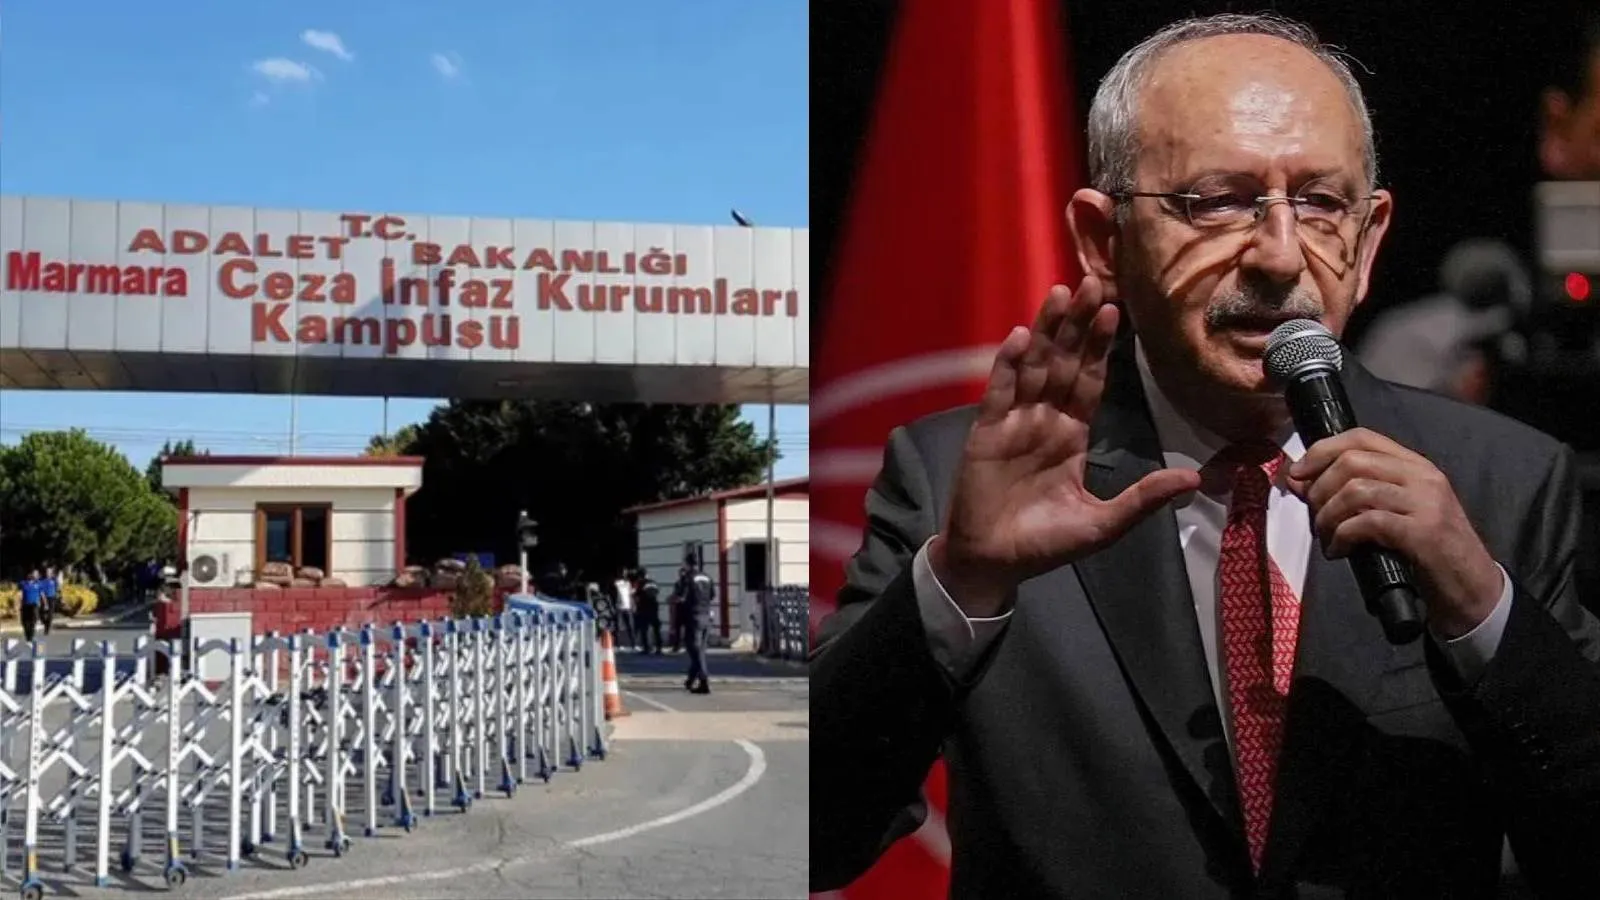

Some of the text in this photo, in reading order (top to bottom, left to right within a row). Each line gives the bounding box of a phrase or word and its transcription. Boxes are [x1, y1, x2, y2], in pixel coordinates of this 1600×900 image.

[340, 213, 416, 240] T.C.
[128, 229, 687, 276] ADALET BAKANLIĞI
[6, 251, 188, 297] Marmara
[218, 258, 356, 305] Ceza
[536, 272, 798, 317] Kurumları
